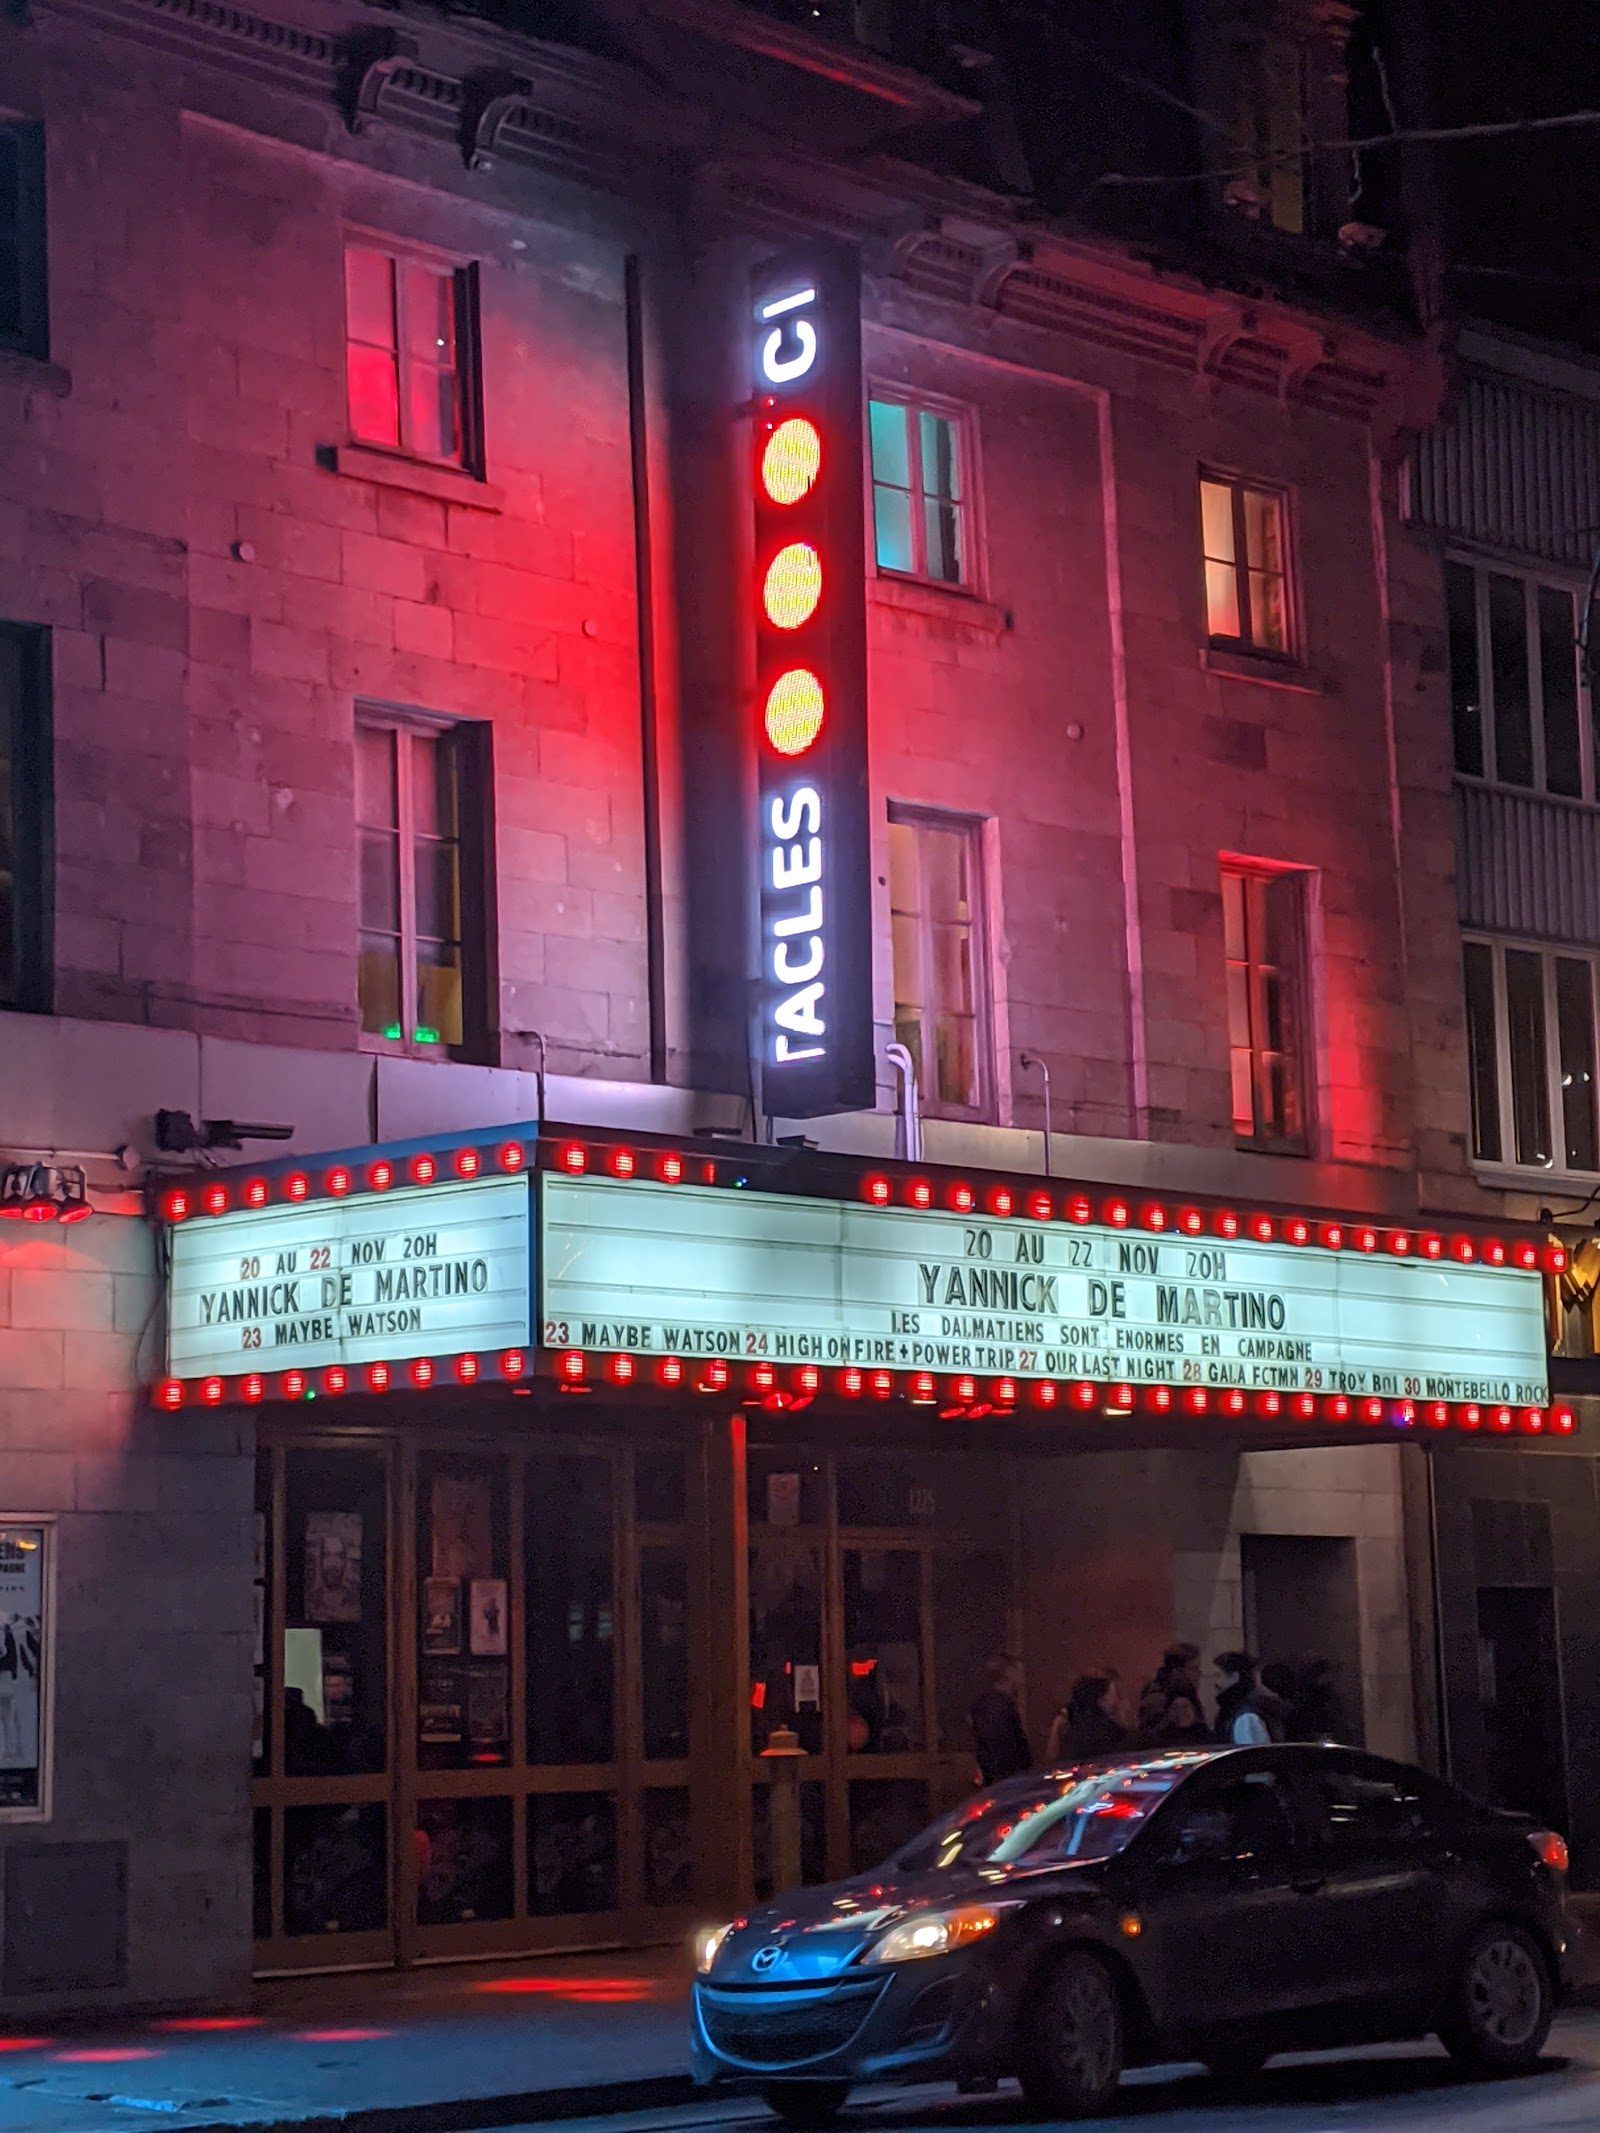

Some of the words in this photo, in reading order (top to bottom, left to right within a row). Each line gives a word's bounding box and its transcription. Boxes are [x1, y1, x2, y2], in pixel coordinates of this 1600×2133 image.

[241, 1256, 260, 1280] 20
[276, 1252, 297, 1275] AU
[310, 1247, 331, 1270] 22
[351, 1239, 385, 1264] NOV
[403, 1233, 437, 1258] 20H
[965, 1228, 992, 1259] 20
[1015, 1233, 1044, 1264] AU
[1070, 1240, 1092, 1267] 22
[1119, 1242, 1159, 1274] NOV
[1186, 1251, 1226, 1281] 20H
[200, 1281, 300, 1323] YANNICK
[321, 1274, 353, 1308] DE
[376, 1258, 488, 1302] MARTINO
[919, 1263, 1059, 1314] YANNICK
[1088, 1278, 1126, 1319] DE
[1156, 1284, 1285, 1330] MARTINO
[242, 1326, 262, 1349] 23
[275, 1318, 333, 1345] MAYBE
[348, 1307, 421, 1336] WATSON
[891, 1310, 920, 1334] LES
[942, 1315, 1044, 1343] DALMATIENS
[1060, 1325, 1099, 1347] SONT
[1116, 1329, 1184, 1353] ENORMES
[1202, 1335, 1220, 1356] EN
[1238, 1338, 1312, 1362] CAMPAGNE
[545, 1321, 570, 1344] 23
[582, 1323, 651, 1347] MAYBE
[662, 1328, 740, 1353] WATSON
[746, 1332, 769, 1355] 24
[776, 1334, 822, 1358] HIGH
[828, 1337, 849, 1359] ON
[854, 1339, 895, 1361] FIRE
[912, 1344, 971, 1367] POWER
[976, 1348, 1015, 1370] TRIP
[1019, 1351, 1037, 1371] 27
[1045, 1352, 1078, 1374] OUR
[1083, 1354, 1120, 1376] LAST
[1127, 1357, 1175, 1381] NIGHT
[1183, 1359, 1201, 1381] 28
[1208, 1364, 1246, 1385] GALA
[1304, 1367, 1323, 1388] 29
[1328, 1370, 1365, 1392] TROY
[1404, 1376, 1420, 1396] 30
[1426, 1377, 1509, 1401] MONTEBELLO
[1516, 1385, 1549, 1404] ROCK
